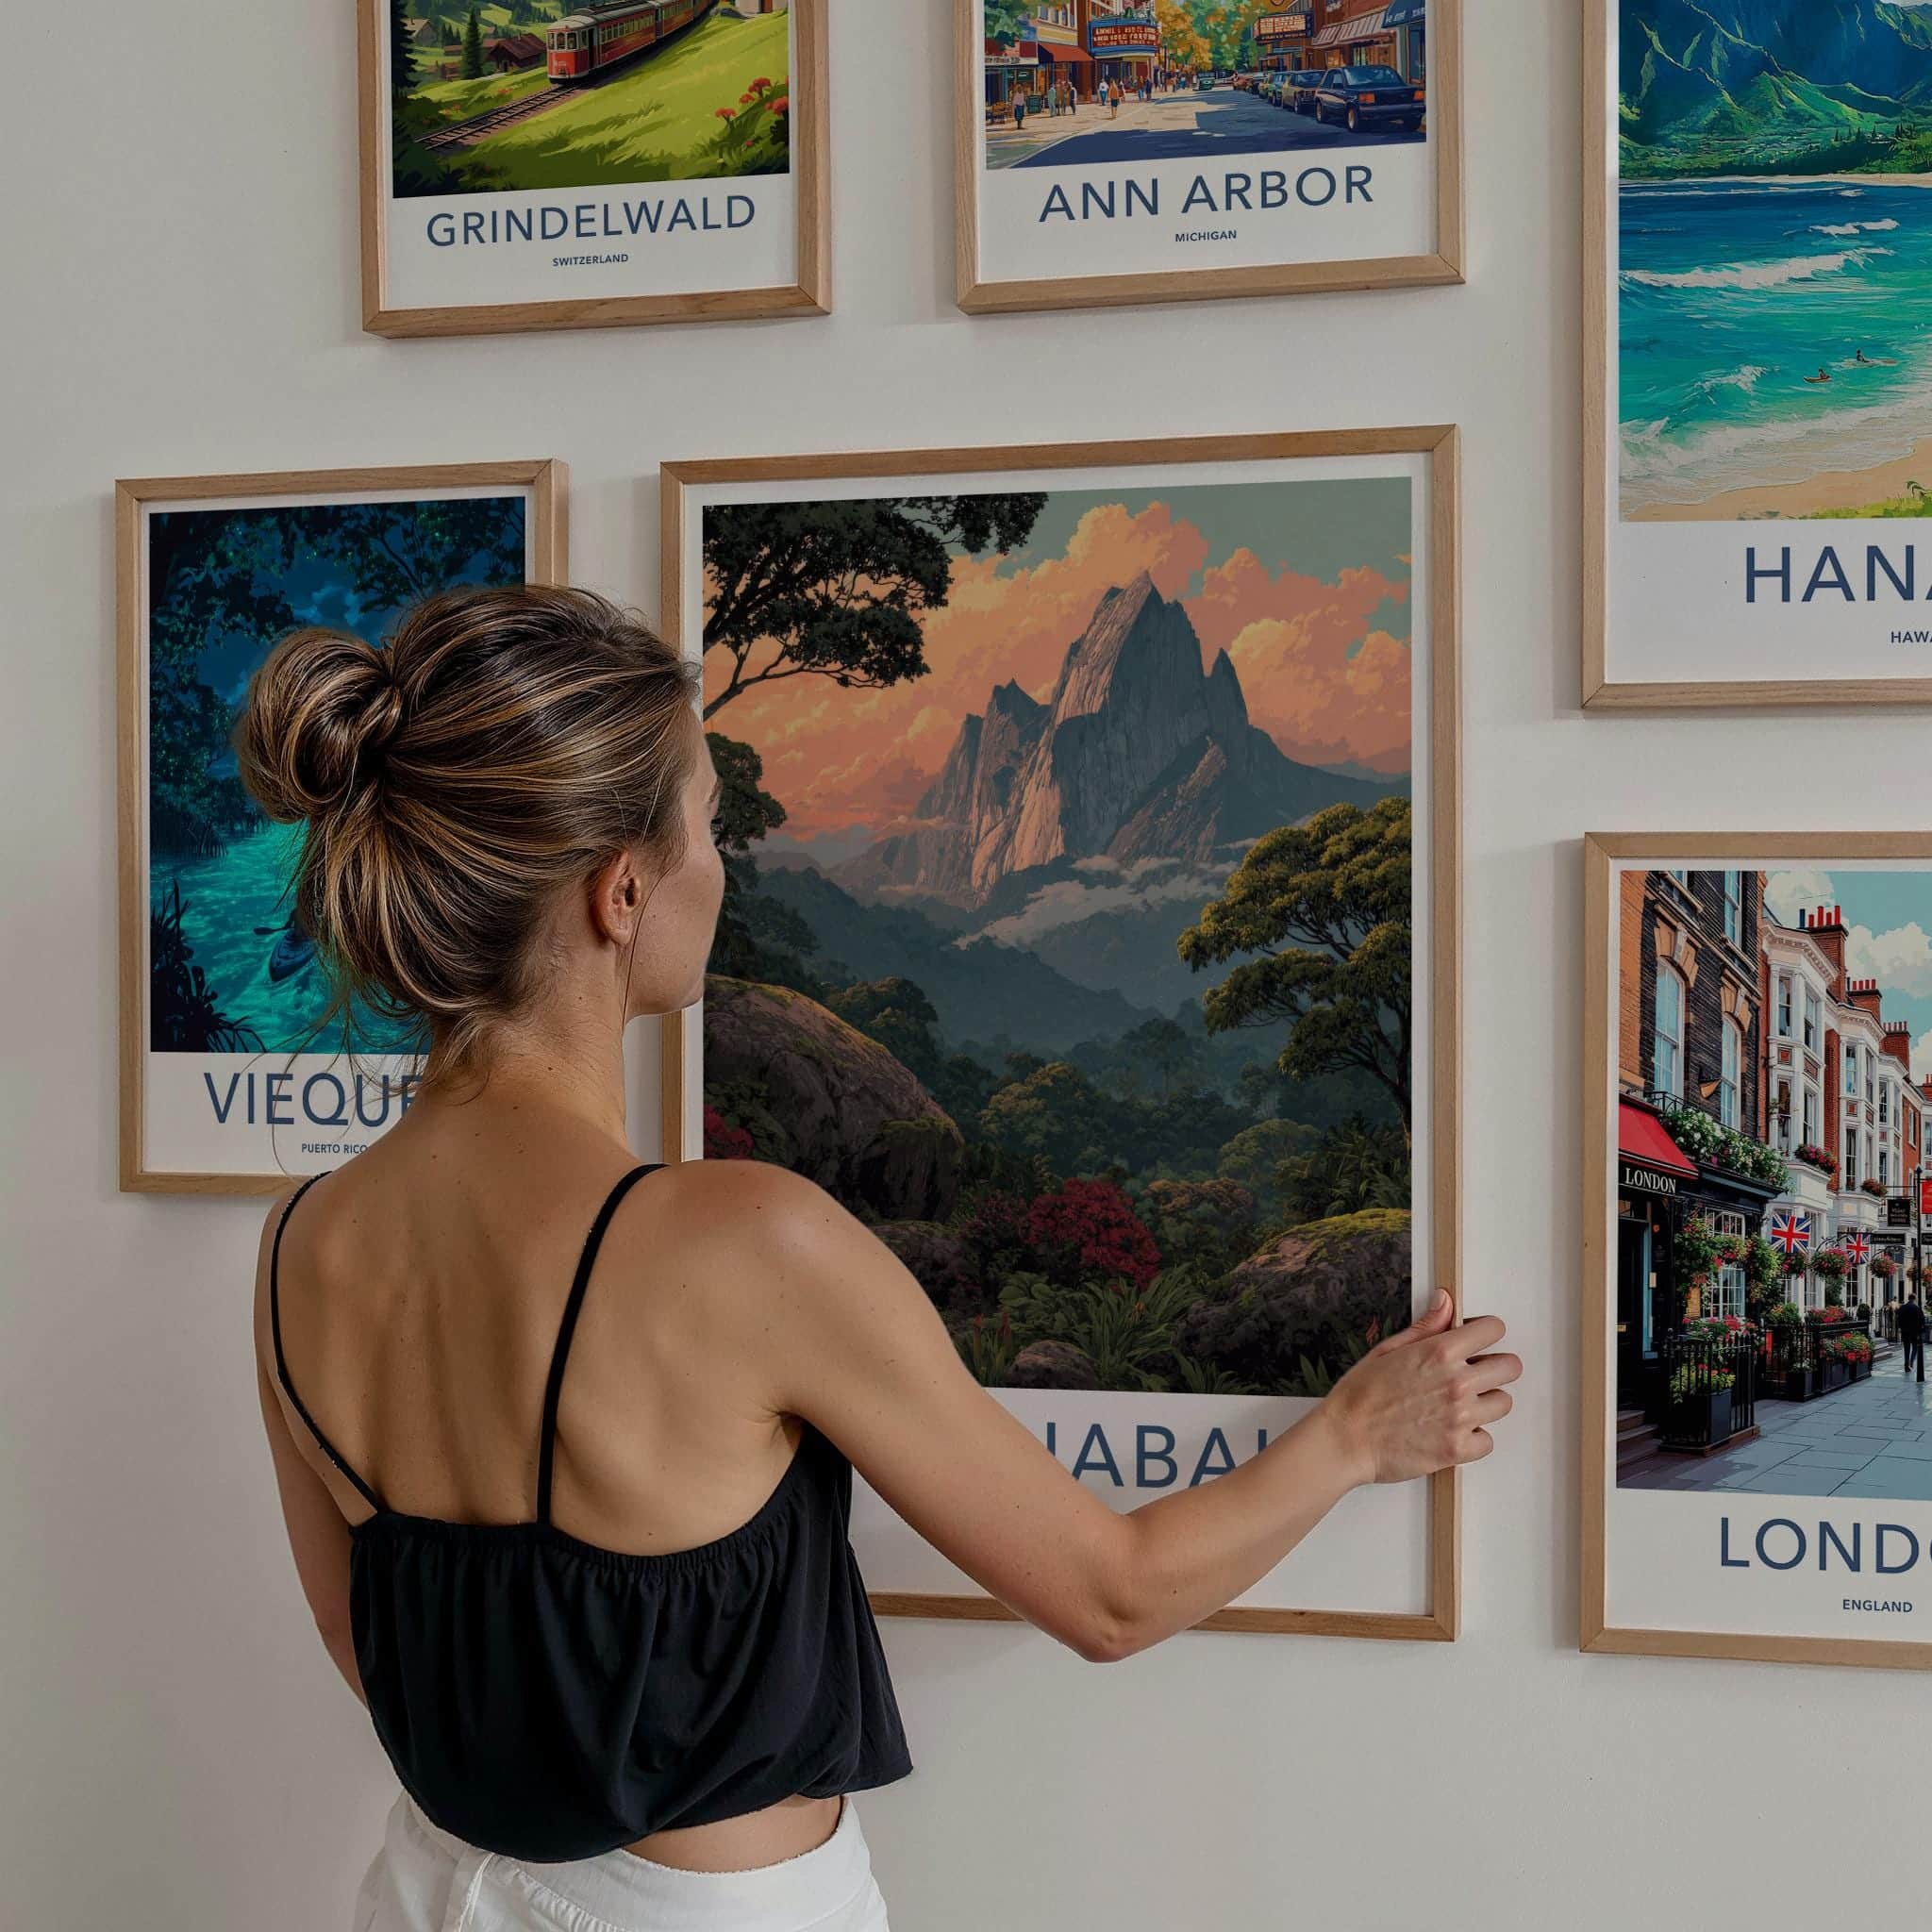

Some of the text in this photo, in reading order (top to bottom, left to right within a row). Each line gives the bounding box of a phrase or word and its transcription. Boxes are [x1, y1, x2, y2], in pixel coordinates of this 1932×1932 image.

[1039, 165, 1374, 223] ANN ARBOR
[426, 194, 756, 247] GRINDELWALD
[1174, 229, 1238, 242] MICHIGAN
[552, 253, 629, 267] SWITZERLAND
[1746, 544, 1932, 603] HAN
[1890, 630, 1932, 643] HAW
[301, 1142, 368, 1155] PUERTO RICO
[1624, 1167, 1676, 1194] LONDON
[1721, 1516, 1932, 1574] LOND
[1842, 1598, 1913, 1613] ENGLAND
